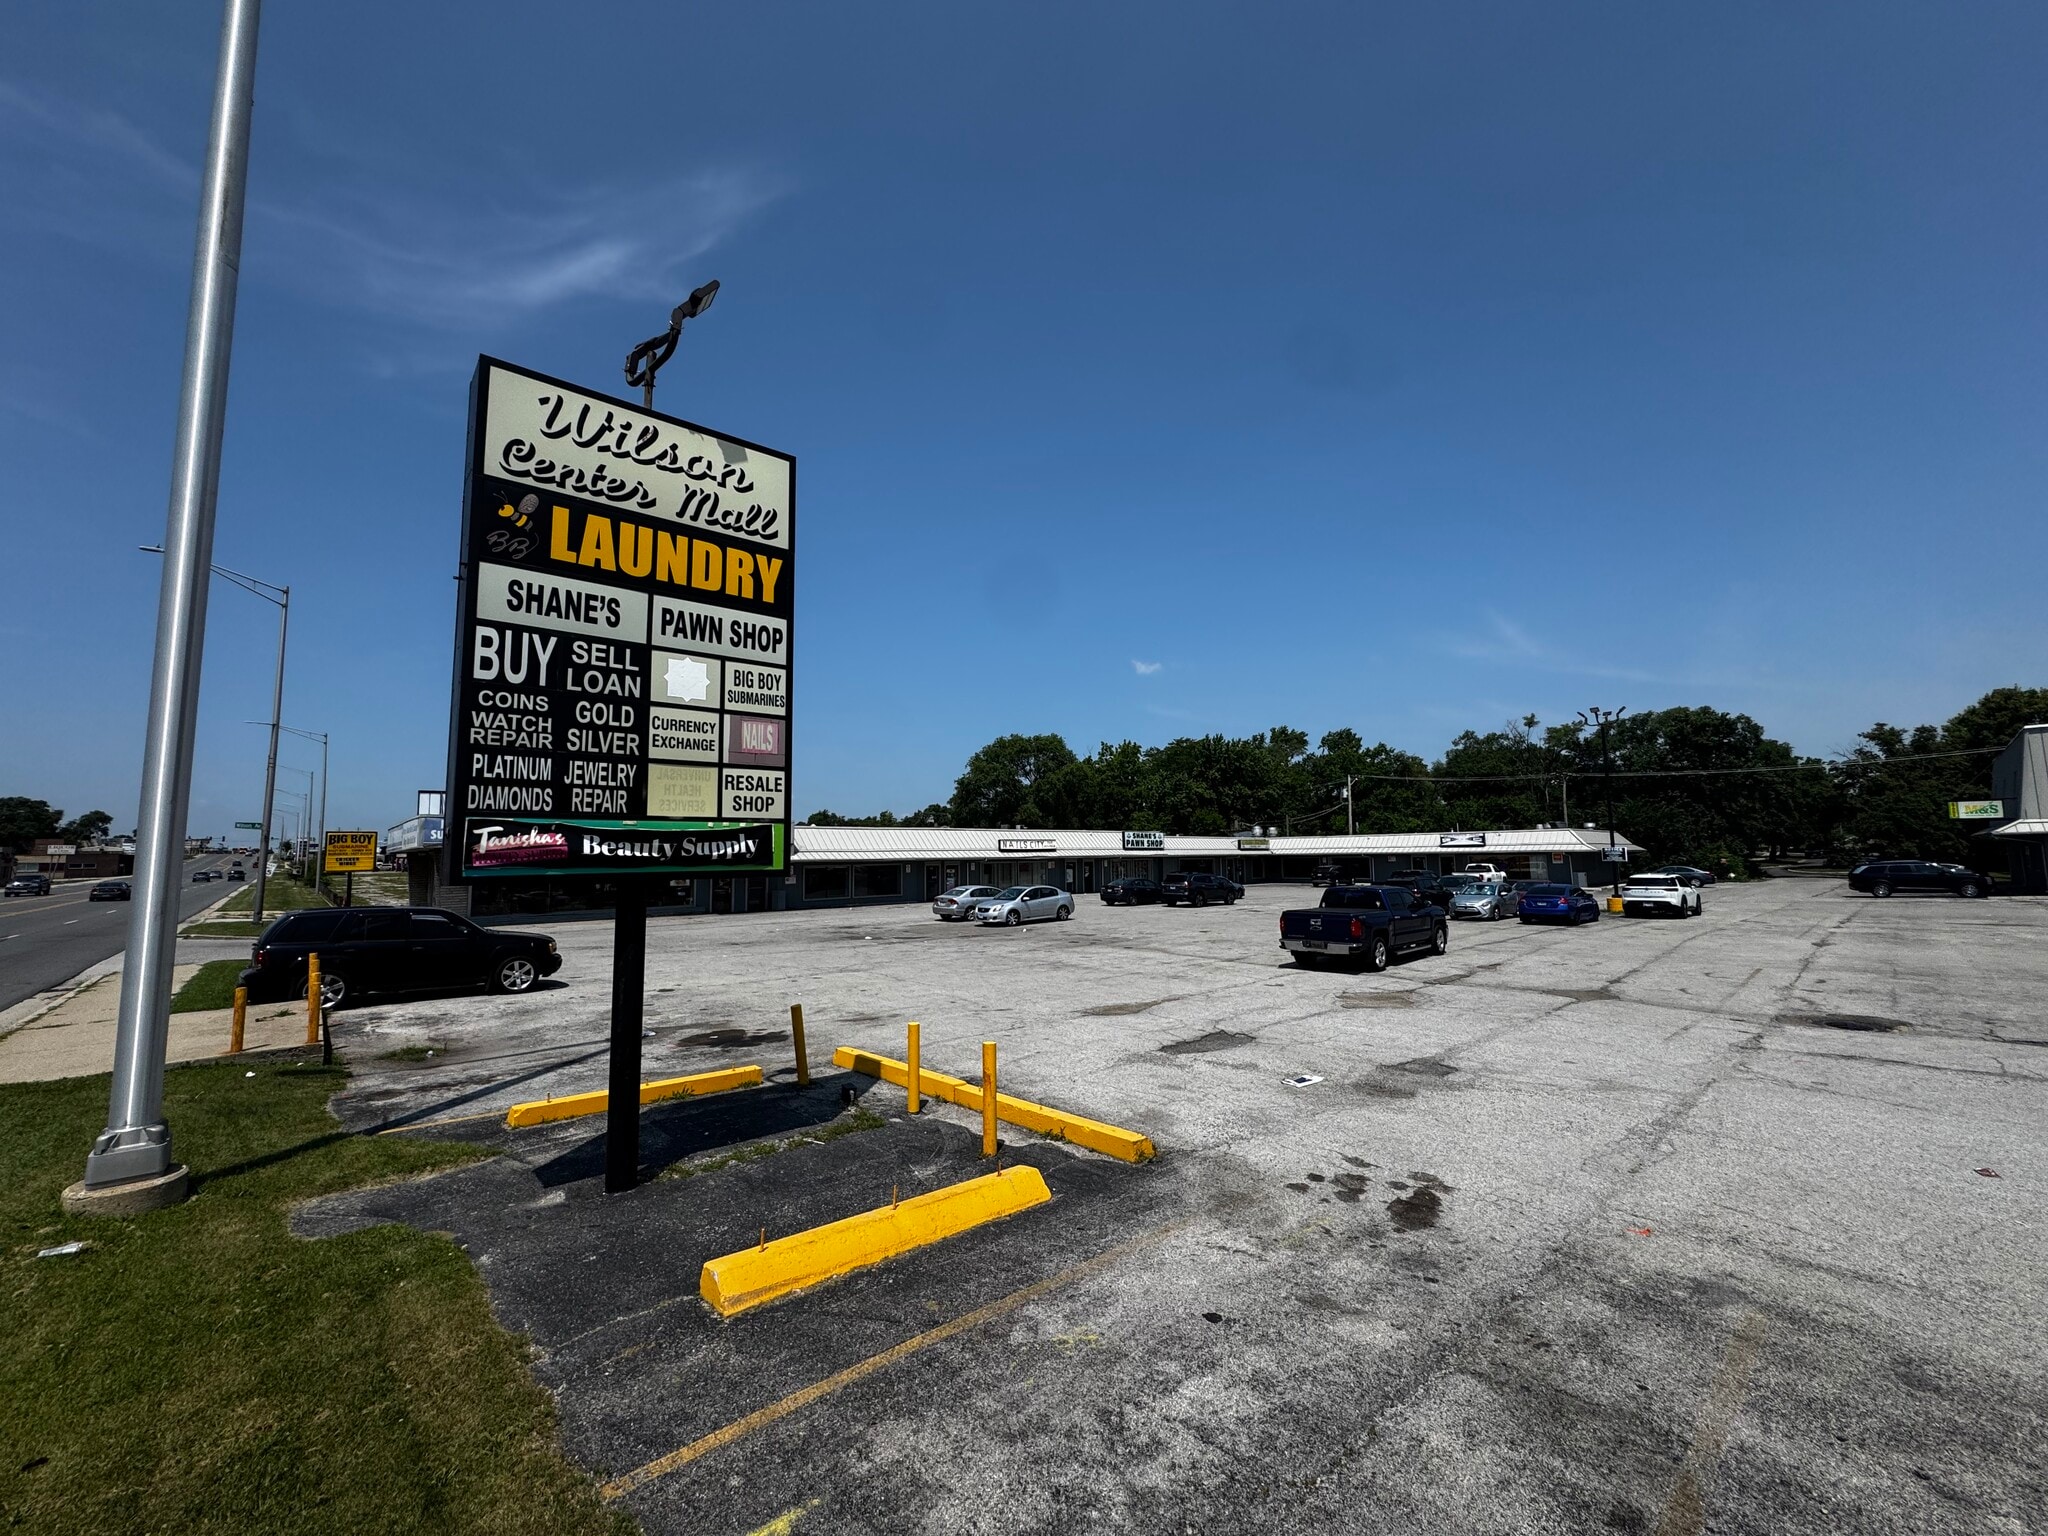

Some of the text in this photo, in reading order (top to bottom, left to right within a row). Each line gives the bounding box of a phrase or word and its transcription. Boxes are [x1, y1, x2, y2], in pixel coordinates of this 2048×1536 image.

[538, 394, 754, 493] Wilson
[499, 438, 779, 540] Center Mall
[550, 505, 783, 604] LAUNDRY
[506, 579, 621, 627] SHANE'S
[661, 607, 784, 654] PAWN SHOP
[473, 625, 558, 687] BUY
[571, 641, 640, 671] SELL
[566, 668, 641, 698] LOAN
[733, 669, 782, 692] BIG BOY
[478, 690, 549, 712] COINS
[727, 689, 785, 709] SUBMARINES
[471, 711, 552, 733] WATCH
[575, 701, 635, 727] GOLD
[652, 715, 716, 735] CURRENCY
[470, 728, 553, 750] REPAIR
[566, 728, 640, 756] SILVER
[652, 733, 716, 752] EXCHANGE
[742, 723, 773, 751] NAILS
[472, 753, 552, 781] PLATINUM
[564, 760, 637, 787] JEWELRY
[724, 774, 783, 792] RESALE
[467, 784, 553, 812] DIAMONDS
[571, 788, 627, 814] REPAIR
[732, 795, 775, 812] SHOP
[328, 834, 348, 845] BIG
[350, 834, 374, 845] BOY
[472, 825, 566, 854] Tanisha's
[582, 832, 760, 862] Beauty Supply
[1002, 840, 1027, 848] NAILS
